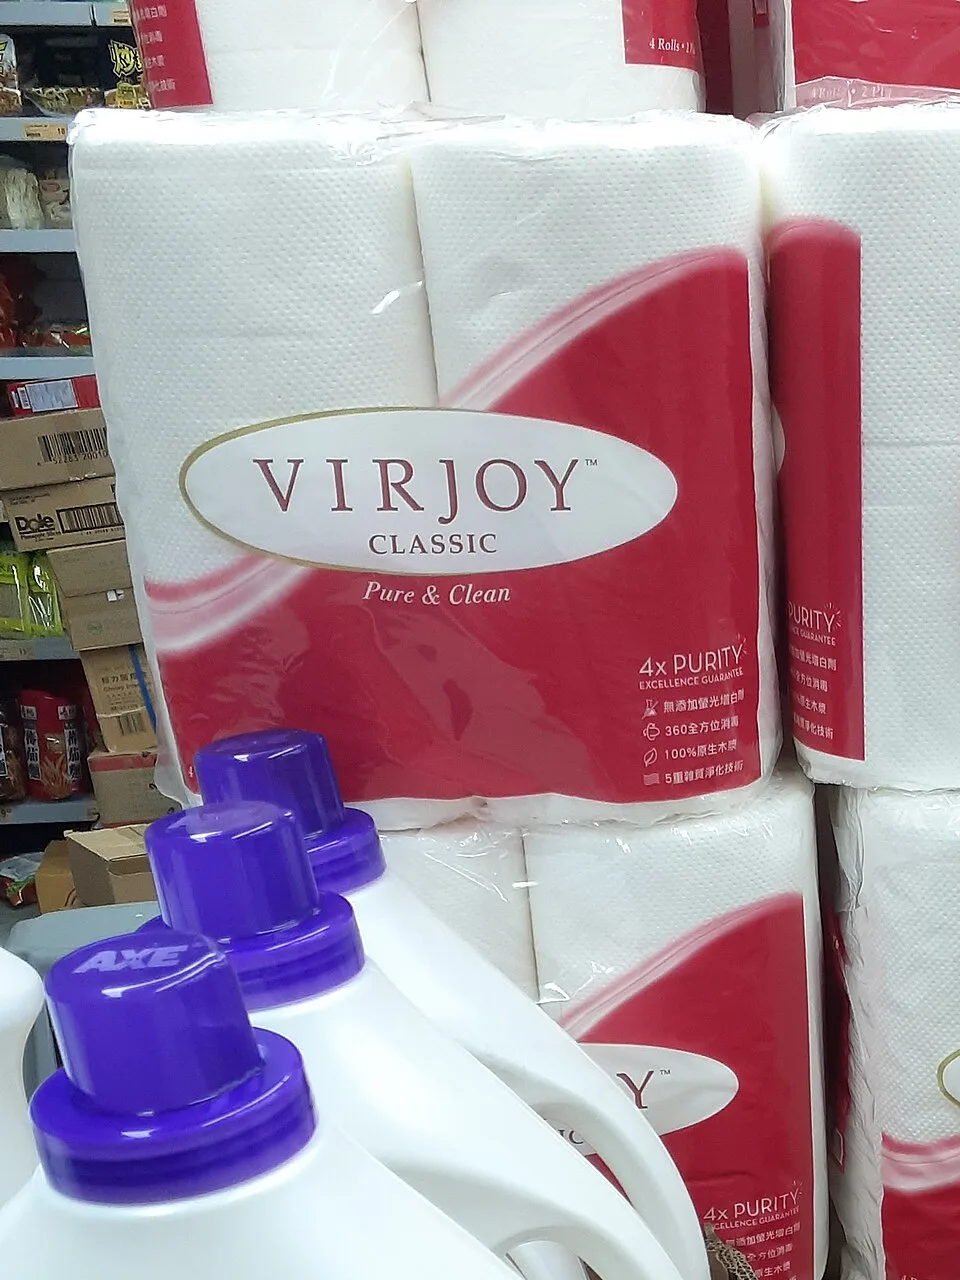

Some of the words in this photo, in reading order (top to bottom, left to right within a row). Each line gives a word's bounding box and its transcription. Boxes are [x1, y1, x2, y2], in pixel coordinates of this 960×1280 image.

[657, 38, 680, 51] Rolls
[252, 458, 580, 524] VIRJOY
[15, 514, 54, 531] Dole
[367, 531, 498, 556] CLASSIC
[362, 580, 415, 604] Pure
[421, 583, 441, 606] &
[449, 580, 511, 604] Clean
[639, 657, 667, 676] 4x
[674, 644, 743, 675] PURITY
[639, 676, 699, 690] EXCELLENCE
[701, 667, 744, 685] GUARANTEE
[74, 945, 187, 975] AXE
[703, 1207, 728, 1221] 4x
[734, 1188, 798, 1218] PURITY
[714, 1219, 757, 1230] CELLENCE
